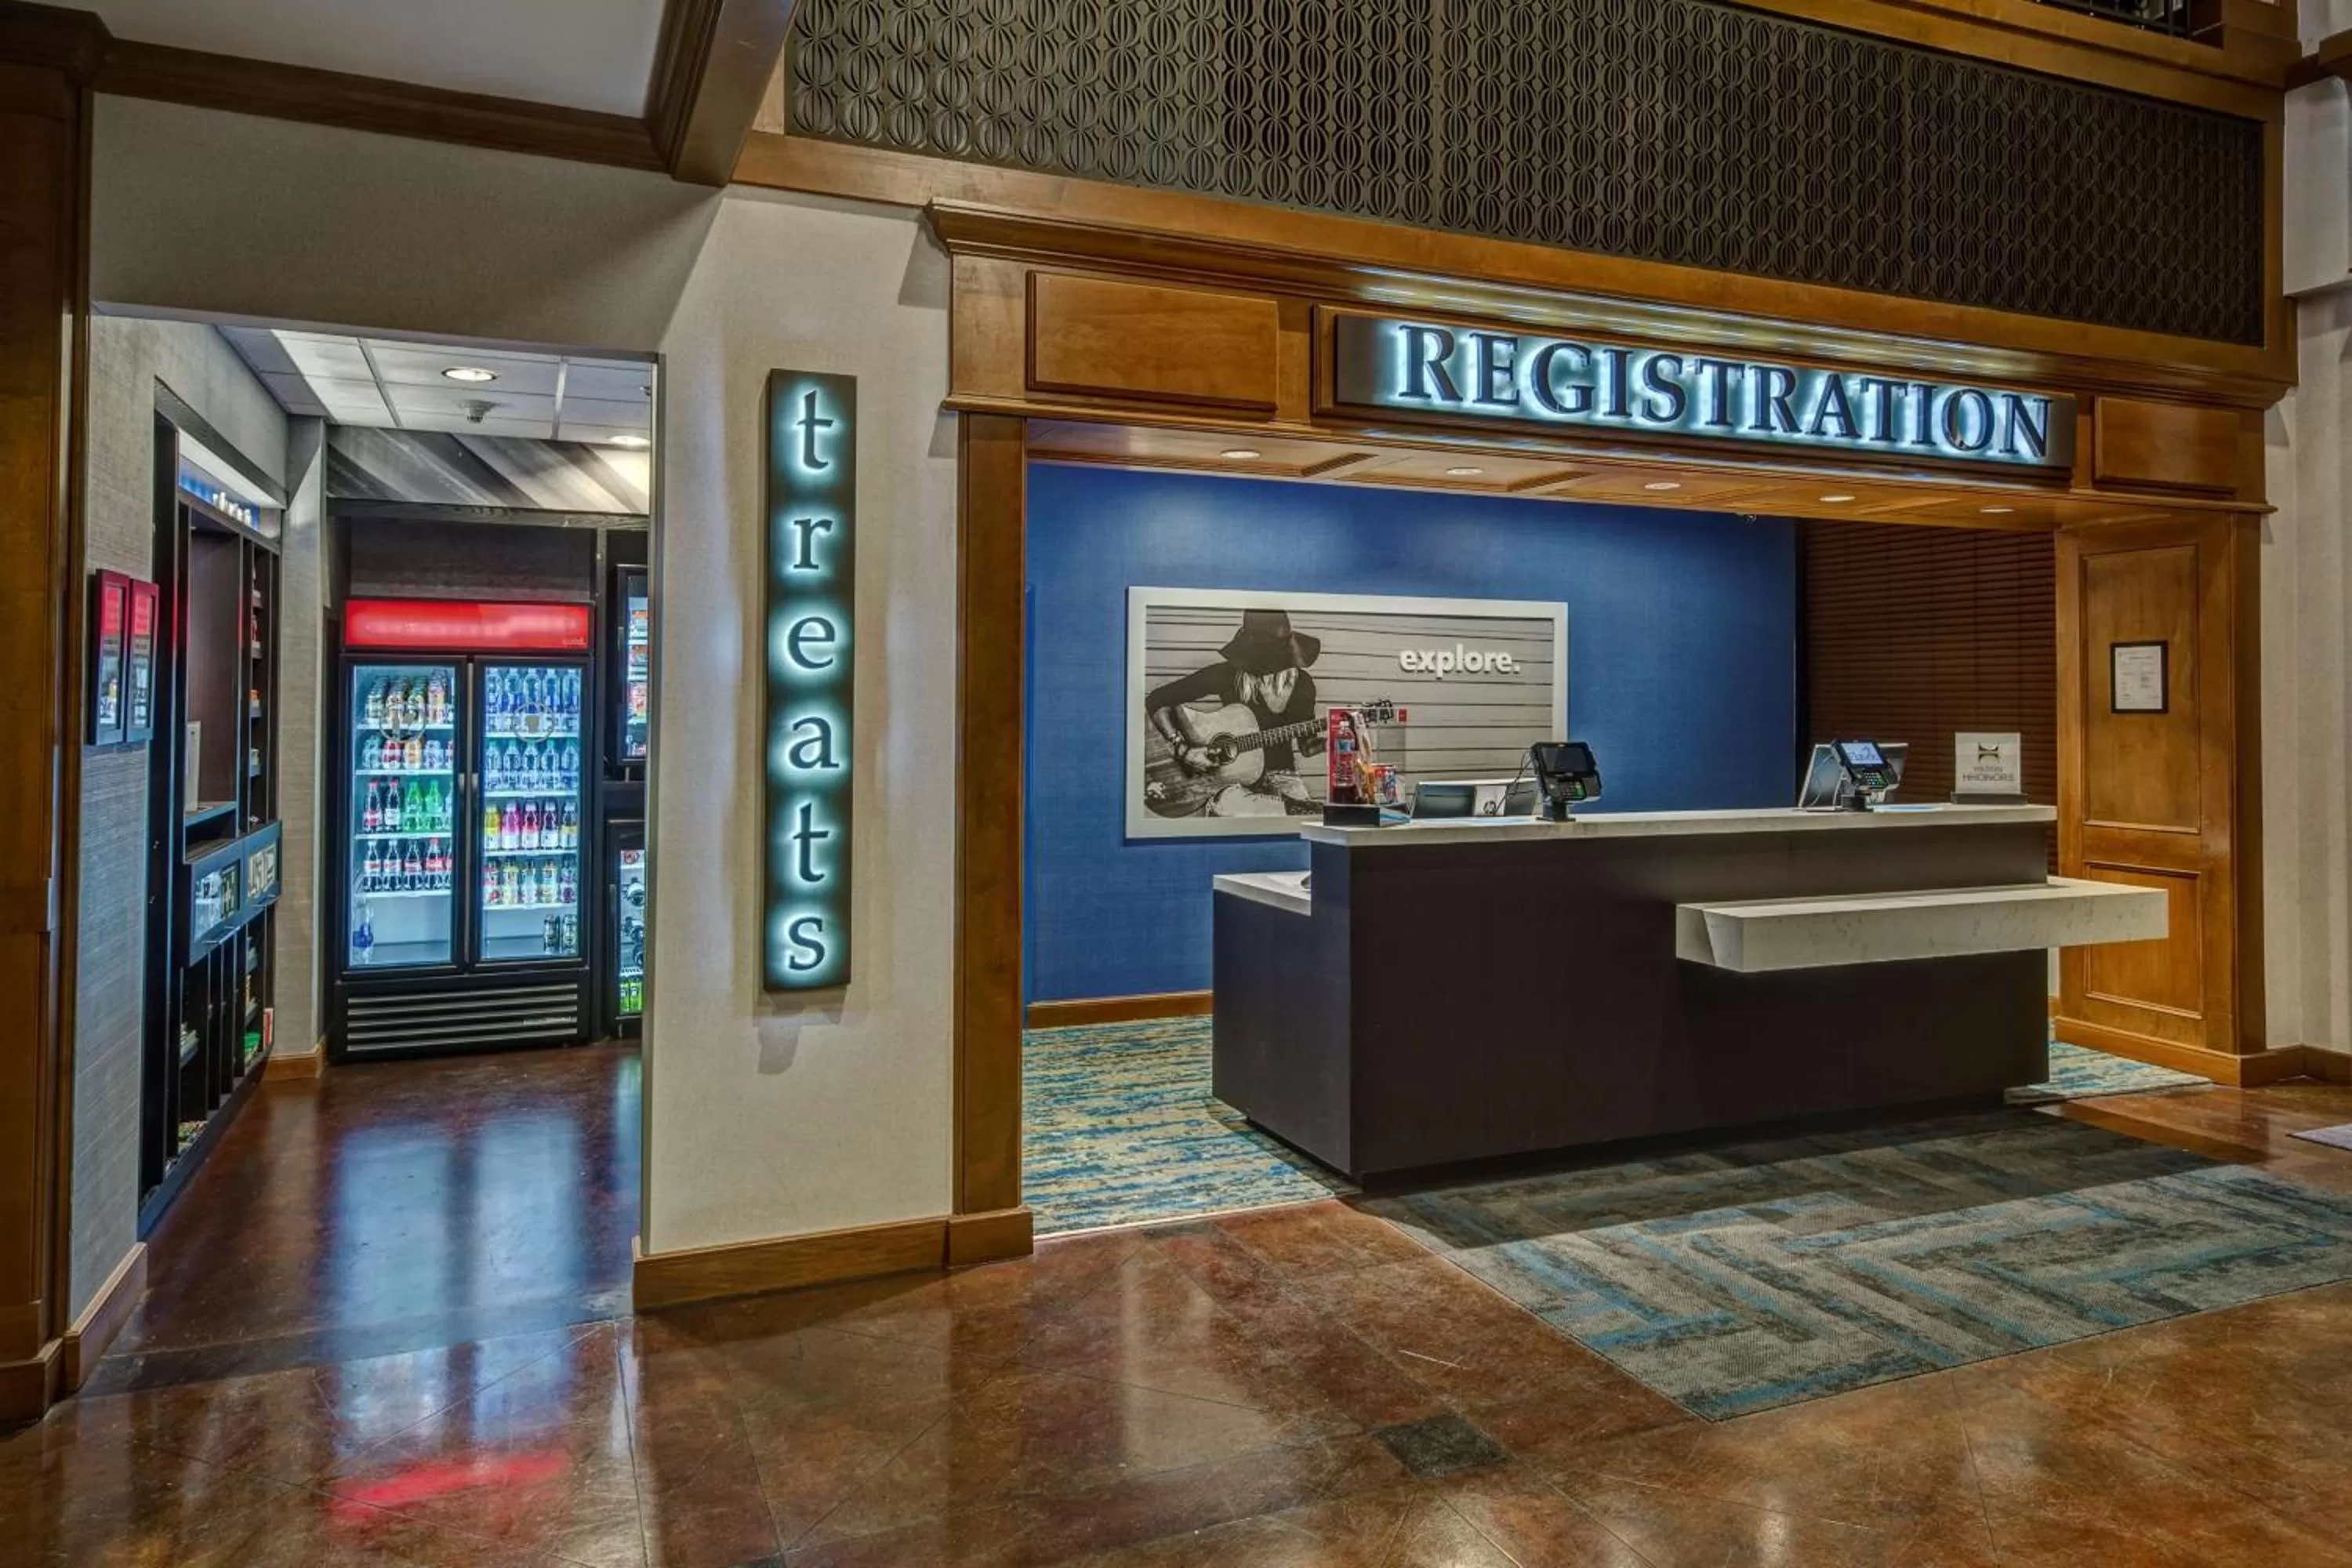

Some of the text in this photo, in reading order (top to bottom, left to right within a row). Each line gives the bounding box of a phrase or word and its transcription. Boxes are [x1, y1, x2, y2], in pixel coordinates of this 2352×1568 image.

[1399, 323, 2055, 459] REGISTRATION
[786, 388, 840, 973] treats
[1399, 642, 1521, 680] explore.
